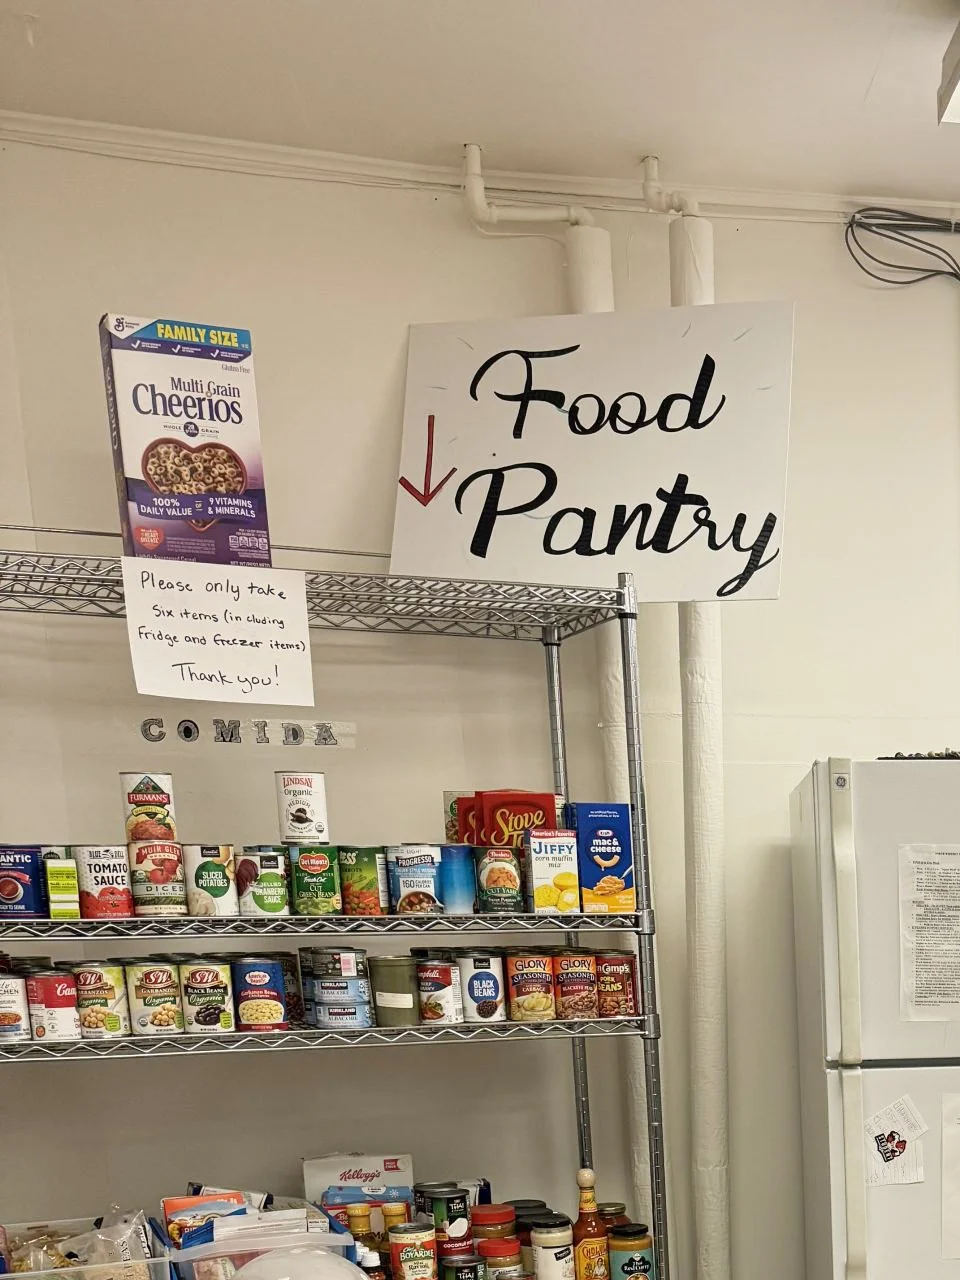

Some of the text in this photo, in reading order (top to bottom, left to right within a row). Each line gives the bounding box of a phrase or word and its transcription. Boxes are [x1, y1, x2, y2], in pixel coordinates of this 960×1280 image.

[156, 323, 239, 348] FAMILY SIZE
[170, 377, 240, 398] Multi Grain
[469, 344, 726, 440] Food
[132, 383, 243, 425] Cheerios
[152, 497, 180, 507] 100%
[215, 497, 253, 508] VITAMINS
[140, 506, 193, 516] DAILY VALUE
[215, 507, 256, 518] MINERALS
[454, 462, 780, 598] Pantry
[141, 571, 287, 601] Please only take
[152, 605, 174, 618] Six
[180, 610, 218, 623] items
[138, 626, 179, 647] Fridge
[184, 634, 207, 646] and
[269, 639, 306, 652] items)
[172, 662, 280, 694] Thank you!
[140, 718, 338, 746] COMIDA
[282, 777, 313, 789] LINDSAY
[284, 788, 312, 797] Organic
[288, 799, 311, 808] MEDIUM
[490, 808, 546, 846] Stove
[612, 838, 619, 846] &
[141, 846, 162, 856] MUIR
[533, 841, 574, 855] JIFFY
[398, 855, 432, 867] PROGRESSO
[87, 863, 128, 873] TOMATO
[94, 875, 126, 885] SAUCE
[202, 871, 223, 879] SLICED
[198, 879, 228, 887] POTATOES
[402, 880, 415, 888] 160
[263, 896, 282, 904] SAUCE
[515, 959, 548, 971] GLORY
[560, 959, 592, 971] GLORY
[602, 963, 629, 974] Camp's
[514, 972, 551, 983] SEASONED
[559, 972, 595, 982] SEASONED
[473, 980, 494, 989] BLACK
[474, 988, 496, 997] BEANS
[189, 994, 223, 1005] Organic
[339, 1168, 382, 1183] Kellogg's
[443, 1241, 466, 1249] coconut
